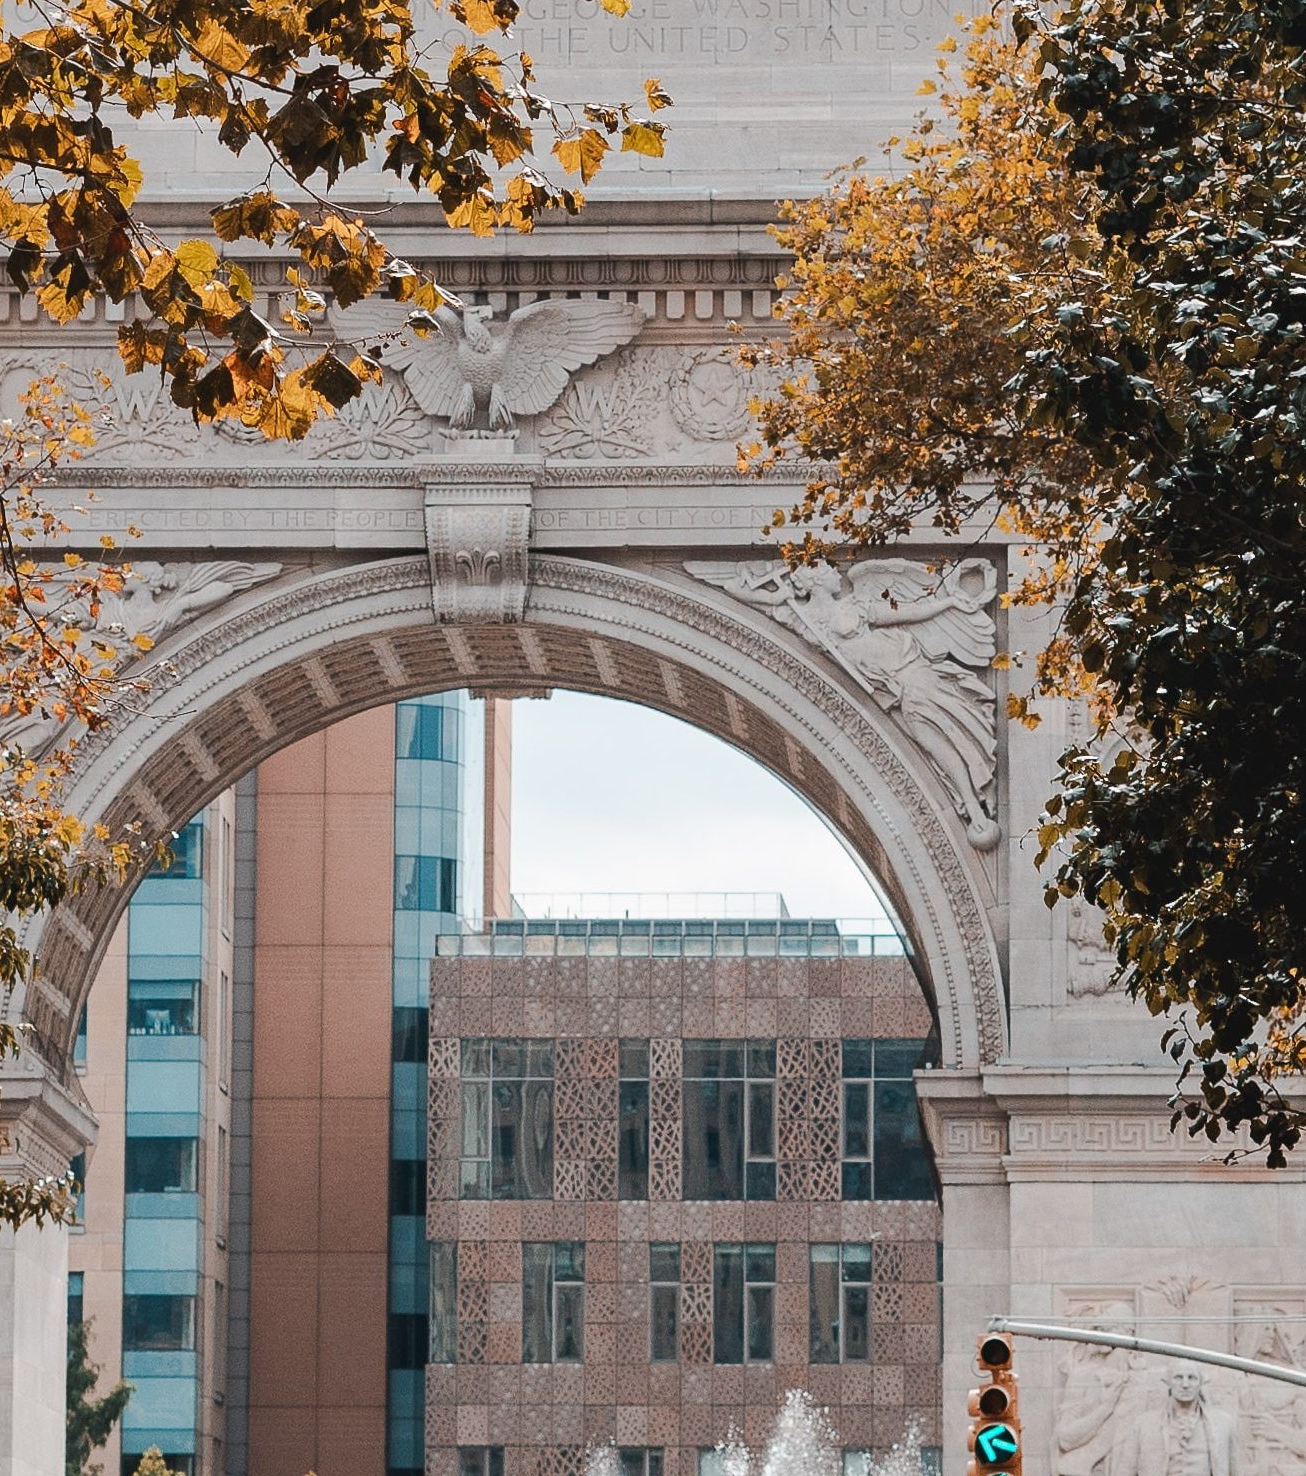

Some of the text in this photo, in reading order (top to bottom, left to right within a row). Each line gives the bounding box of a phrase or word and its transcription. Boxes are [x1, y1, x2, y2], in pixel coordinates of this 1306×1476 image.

[525, 0, 672, 20] GEOGE
[513, 27, 589, 53] THE
[608, 26, 749, 53] UNITED
